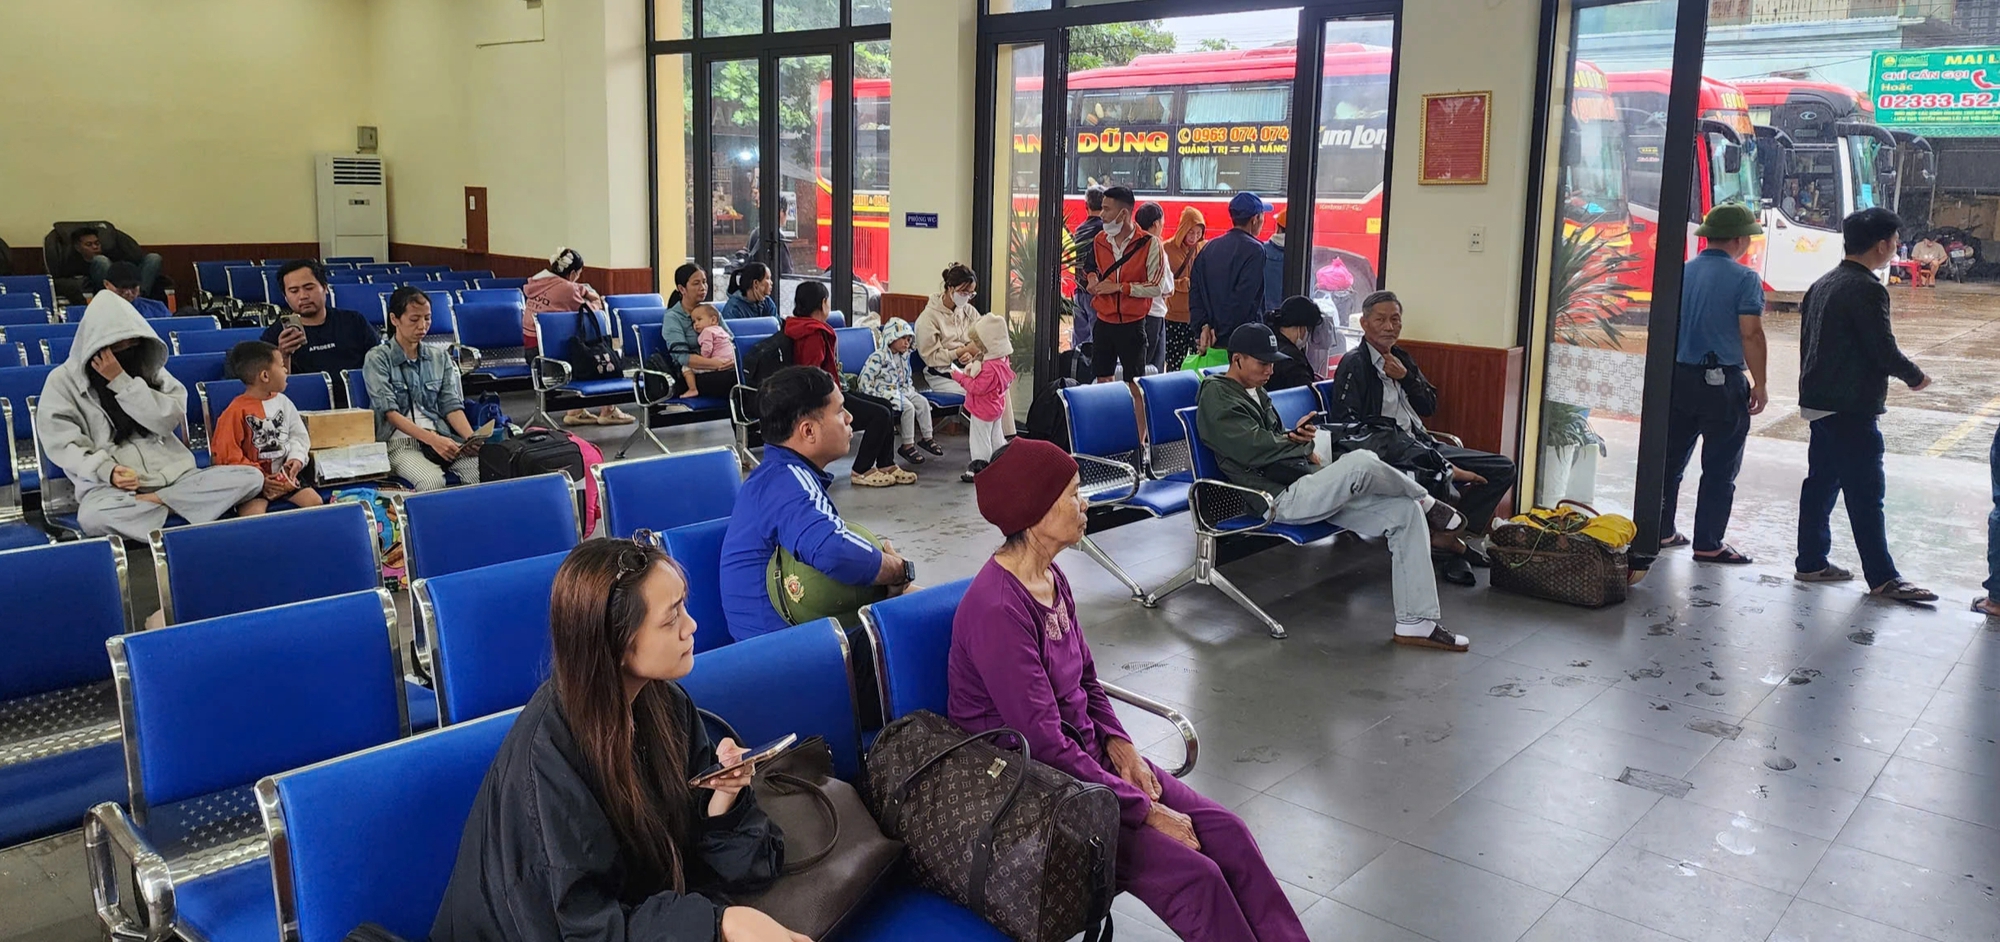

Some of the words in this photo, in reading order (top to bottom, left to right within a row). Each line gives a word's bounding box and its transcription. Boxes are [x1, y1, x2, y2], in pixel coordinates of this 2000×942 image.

[1944, 54, 1983, 66] MAI
[1988, 53, 2000, 64] L
[1878, 93, 2000, 109] 02333.52.
[1077, 128, 1169, 153] DŨNG
[1192, 128, 1227, 142] 0963
[1229, 127, 1258, 142] 074
[1260, 126, 1289, 141] 074
